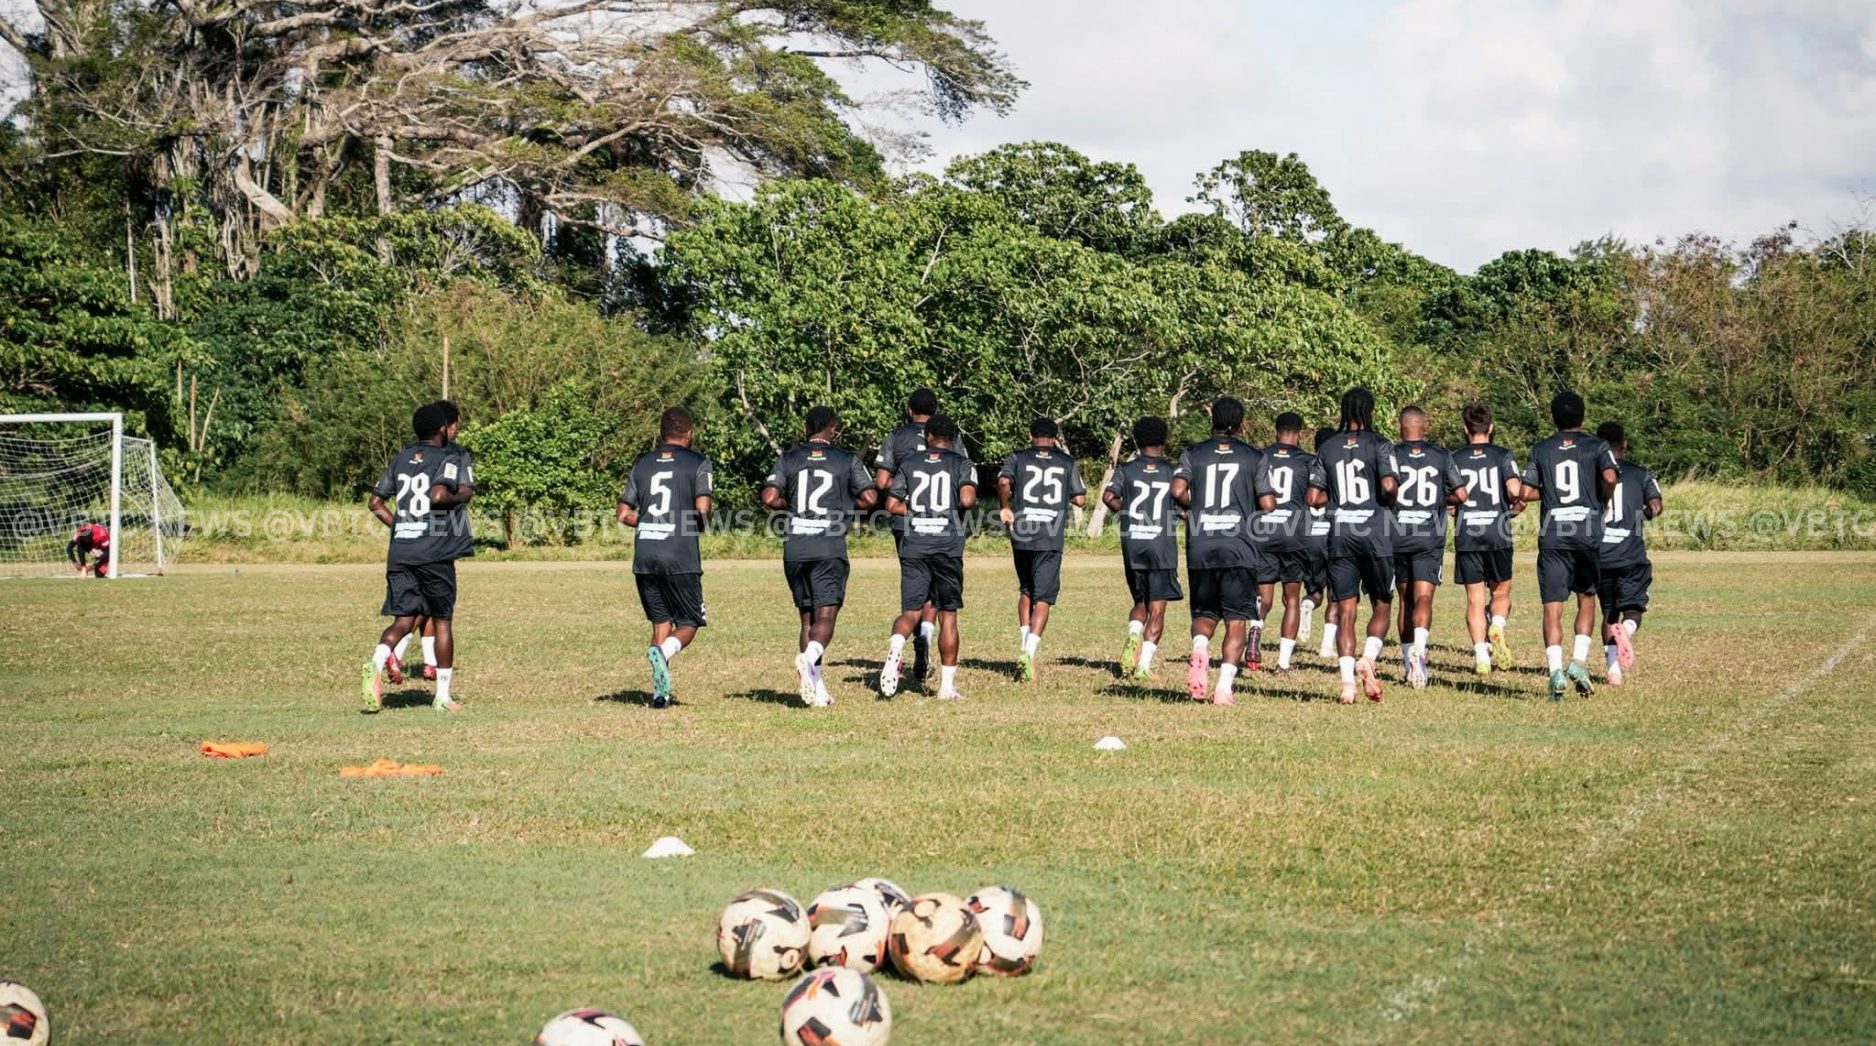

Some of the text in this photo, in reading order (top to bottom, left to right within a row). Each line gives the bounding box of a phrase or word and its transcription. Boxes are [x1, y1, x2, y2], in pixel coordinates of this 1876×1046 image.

[396, 473, 430, 517] 28
[648, 471, 673, 517] 5
[798, 469, 833, 515] 12
[911, 471, 950, 513] 20
[1023, 465, 1064, 504] 25
[1129, 480, 1170, 520] 27
[1205, 463, 1239, 508] 17
[1268, 465, 1293, 504] 9
[1336, 459, 1370, 505] 16
[1397, 466, 1438, 506] 26
[1461, 467, 1499, 506] 24
[1556, 460, 1579, 503] 9
